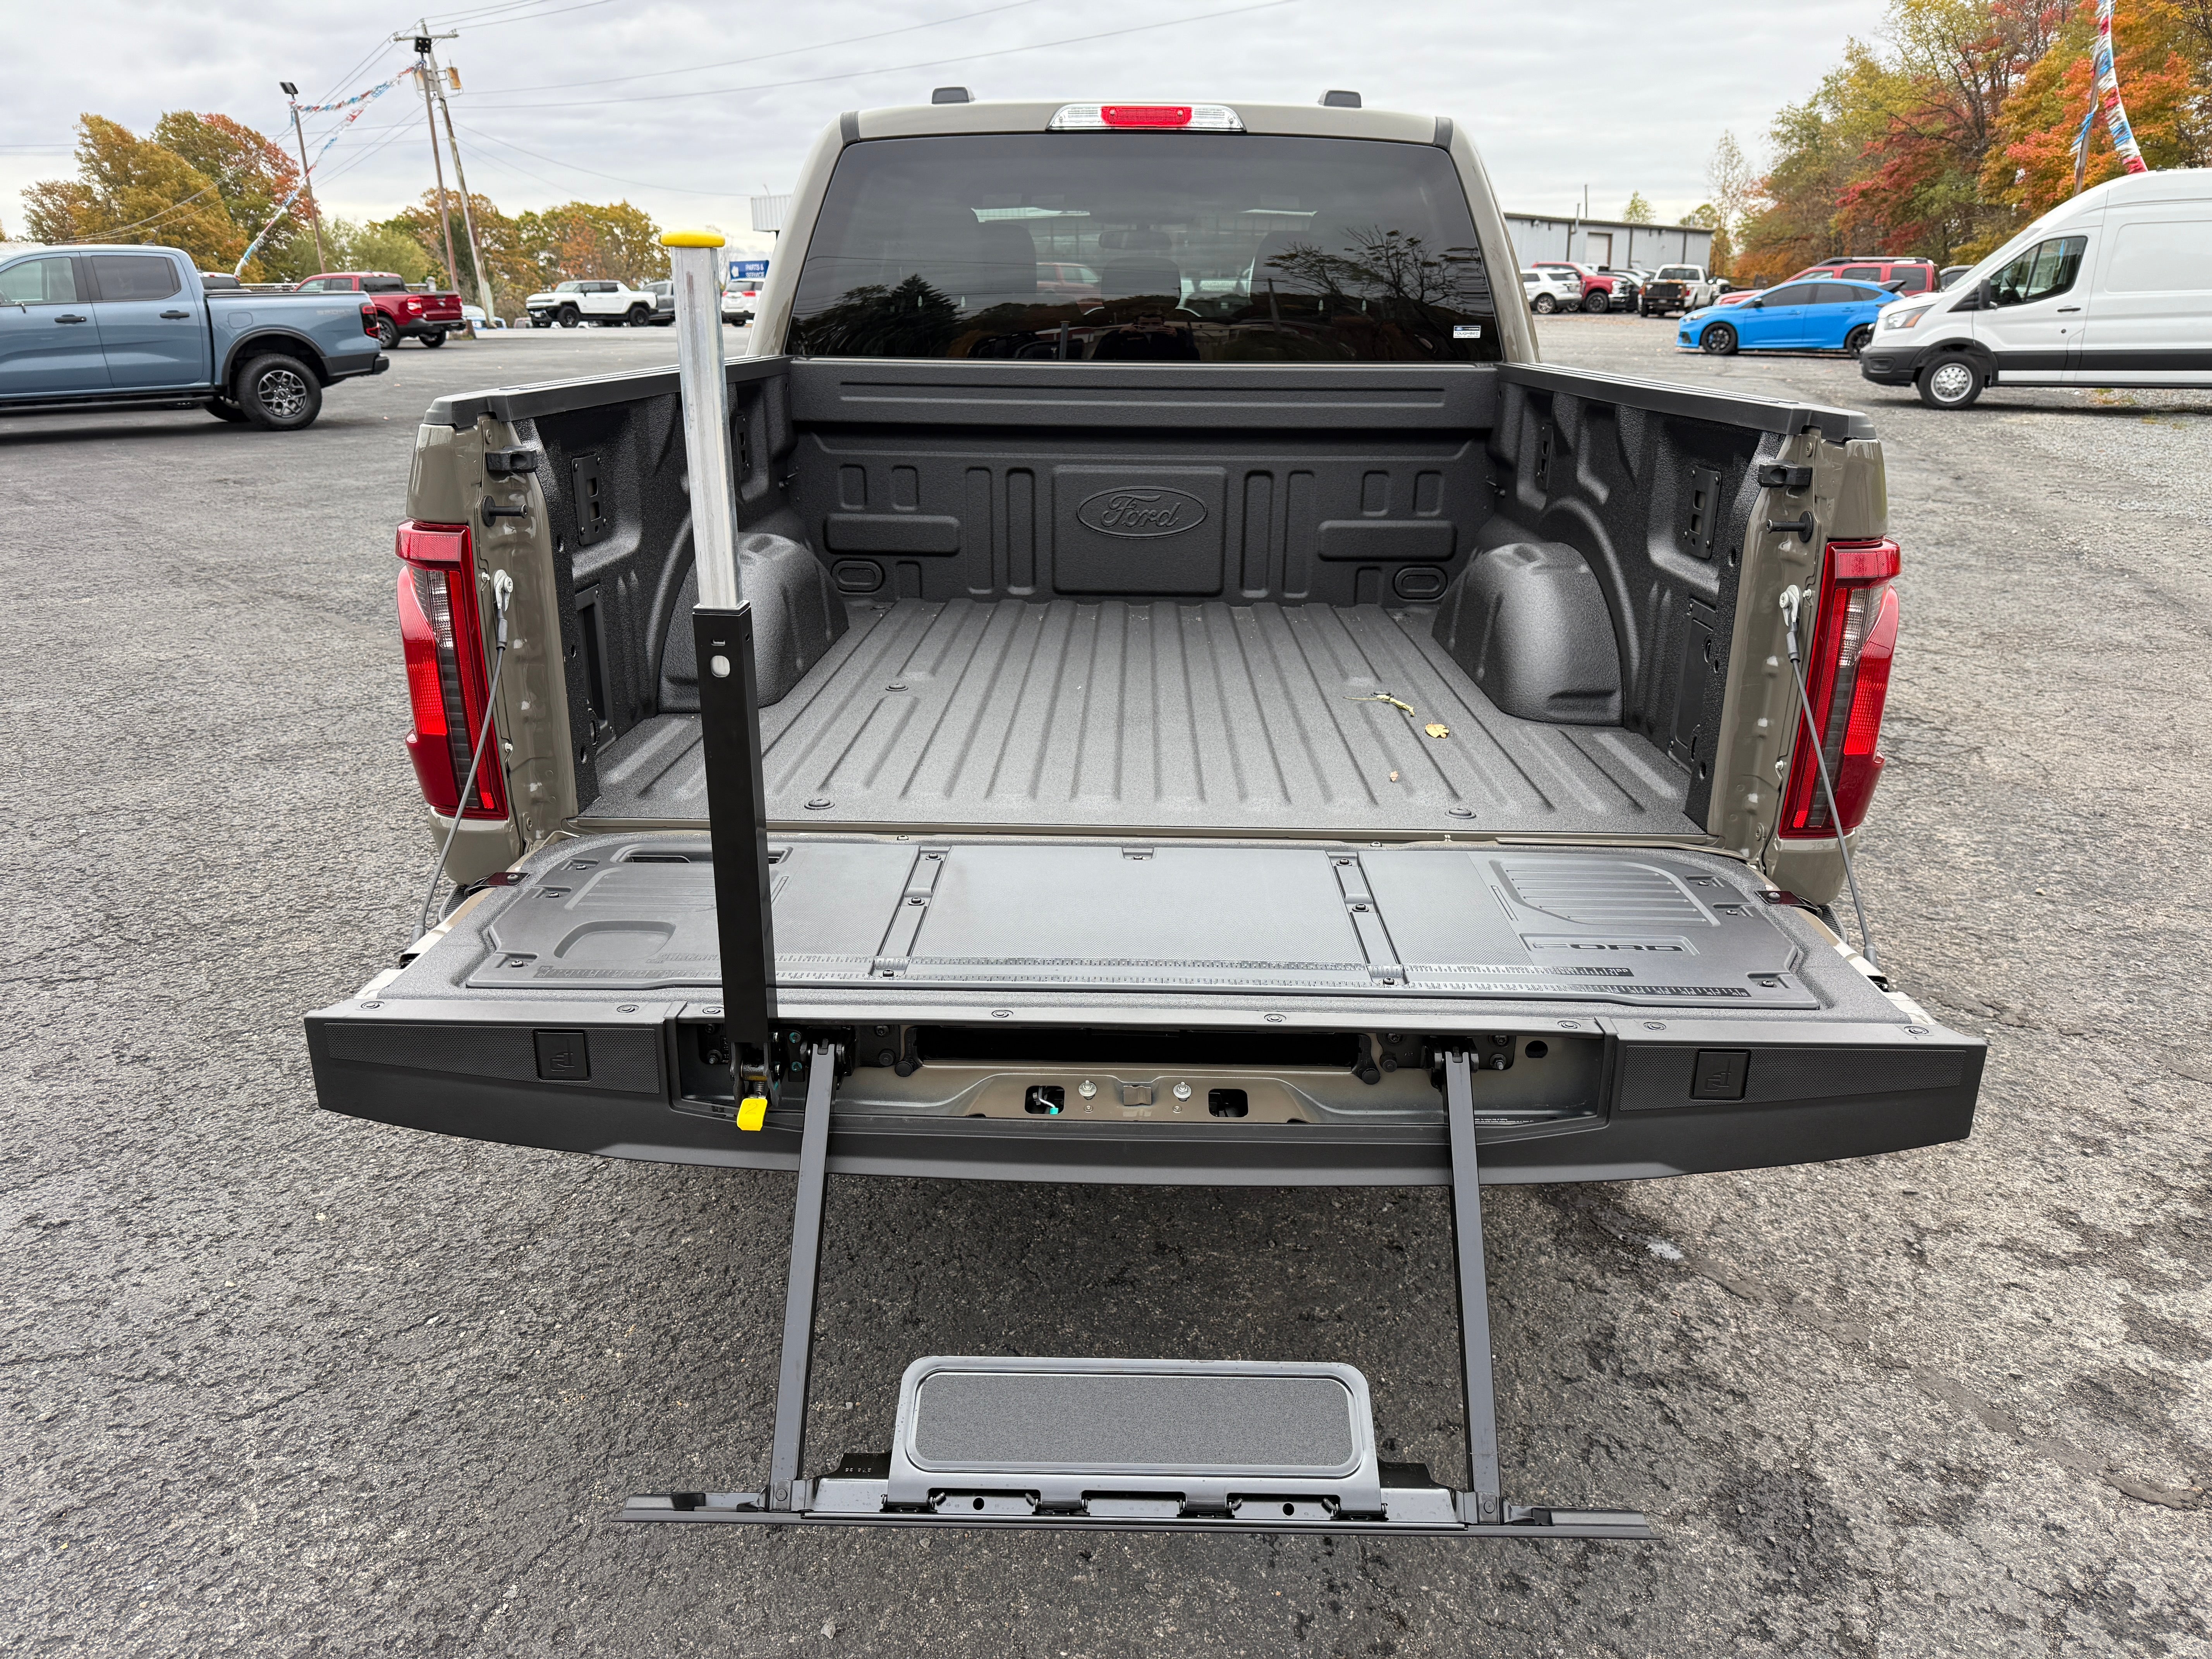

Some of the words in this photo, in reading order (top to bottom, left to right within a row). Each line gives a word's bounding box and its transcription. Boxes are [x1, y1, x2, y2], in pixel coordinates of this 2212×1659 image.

[1101, 494, 1181, 527] Ford
[1532, 943, 1685, 951] FORD
[745, 1102, 759, 1115] 2
